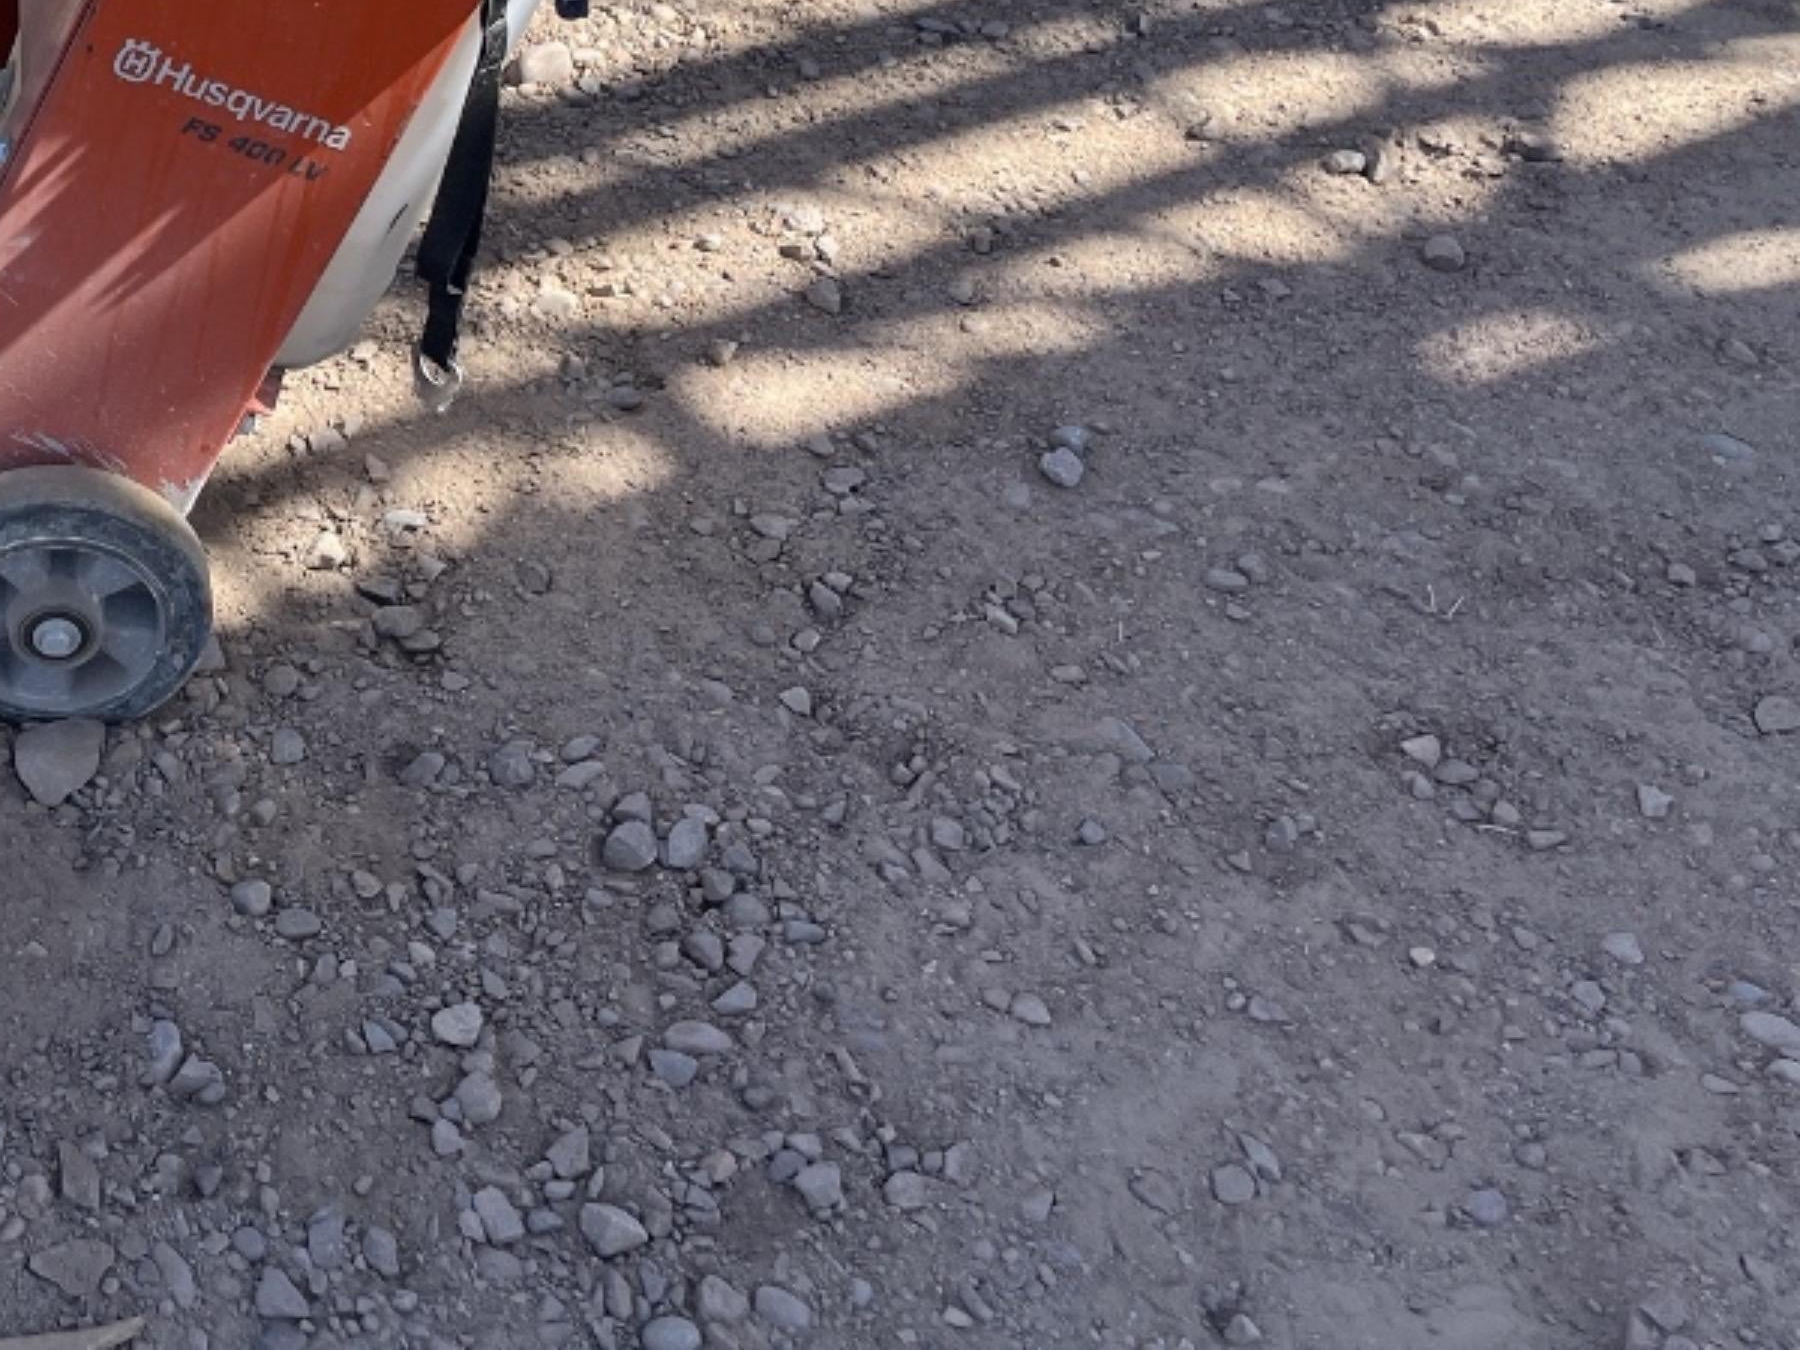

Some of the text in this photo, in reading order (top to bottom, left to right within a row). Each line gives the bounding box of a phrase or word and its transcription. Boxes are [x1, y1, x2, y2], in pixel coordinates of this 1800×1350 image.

[153, 55, 352, 151] Husqvarna
[180, 116, 223, 142] FS
[228, 134, 287, 166] 400
